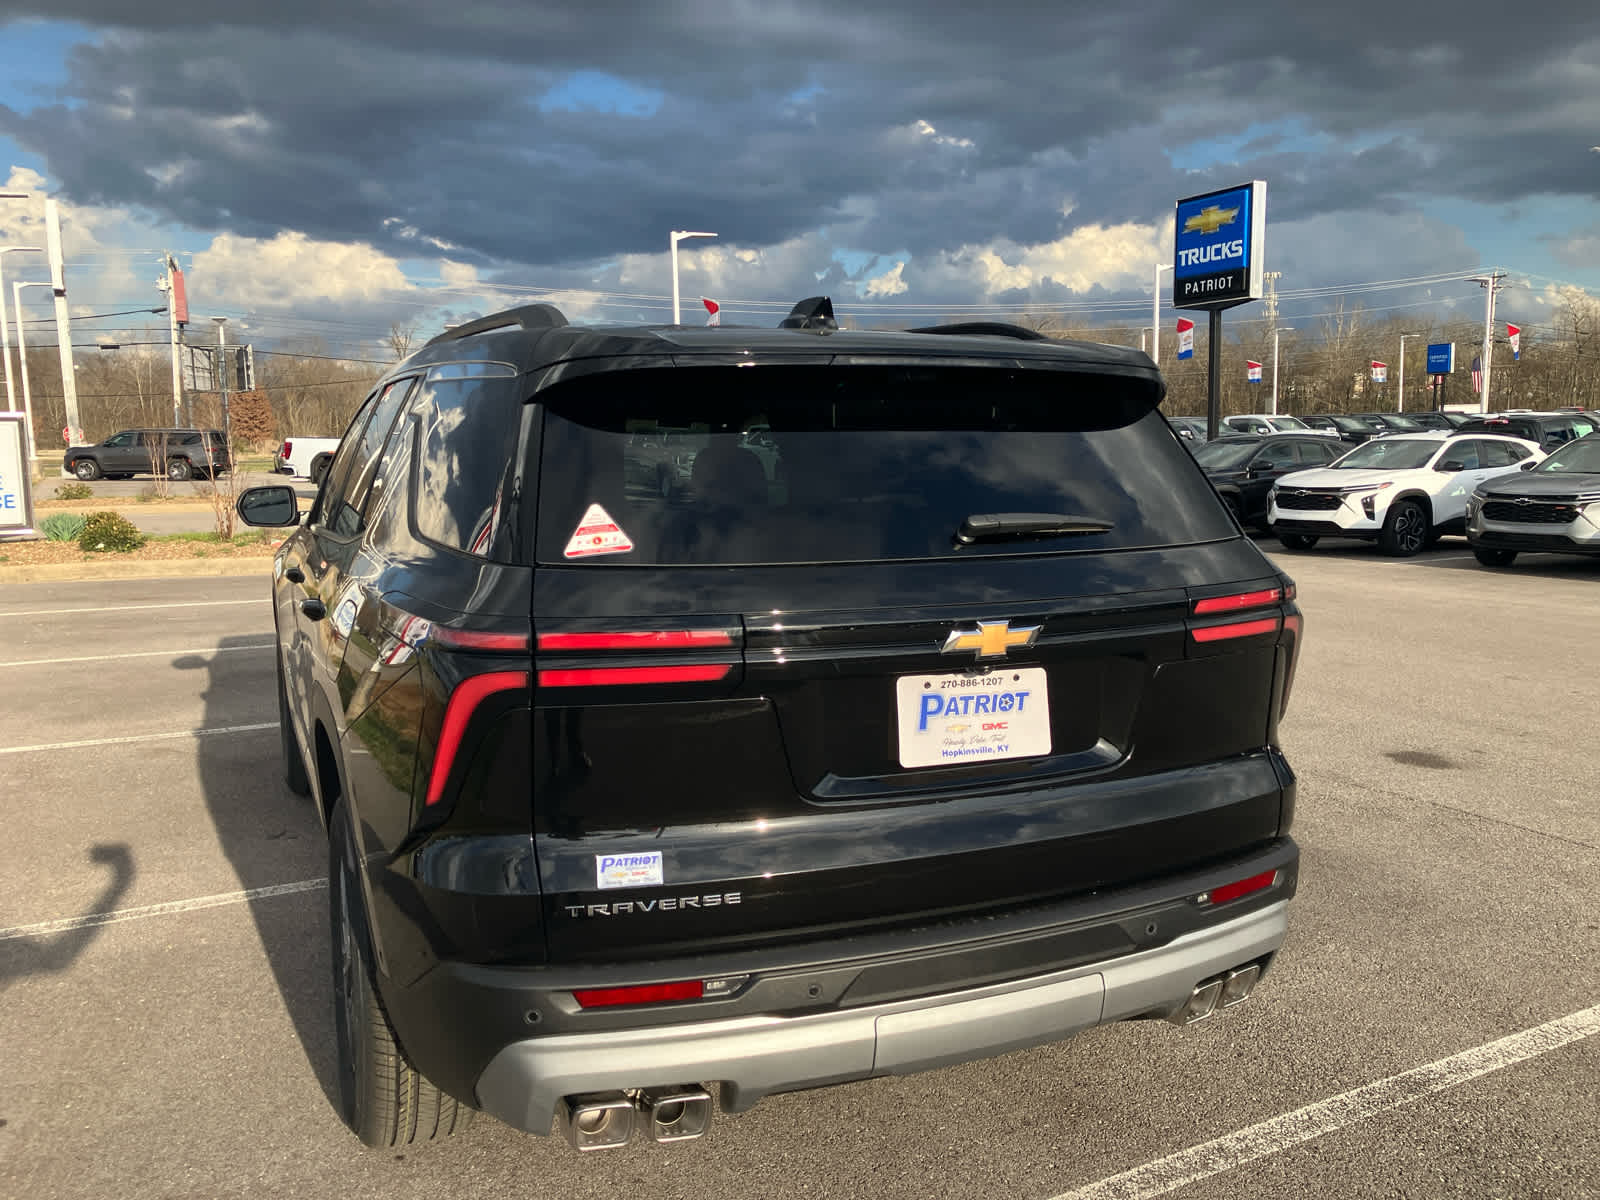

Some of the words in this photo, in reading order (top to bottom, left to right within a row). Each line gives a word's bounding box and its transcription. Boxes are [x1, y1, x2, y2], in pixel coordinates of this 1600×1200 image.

[1179, 239, 1243, 267] TRUCKS
[1185, 276, 1233, 295] PATRIOT
[940, 677, 1003, 689] 270-886-1207
[918, 691, 1030, 732] PATRIOT
[982, 722, 1008, 731] GMC
[942, 746, 995, 757] Hopkinsville,
[997, 744, 1009, 753] KY
[600, 855, 659, 873] PATRIOT
[564, 892, 742, 918] TRAVERSE
